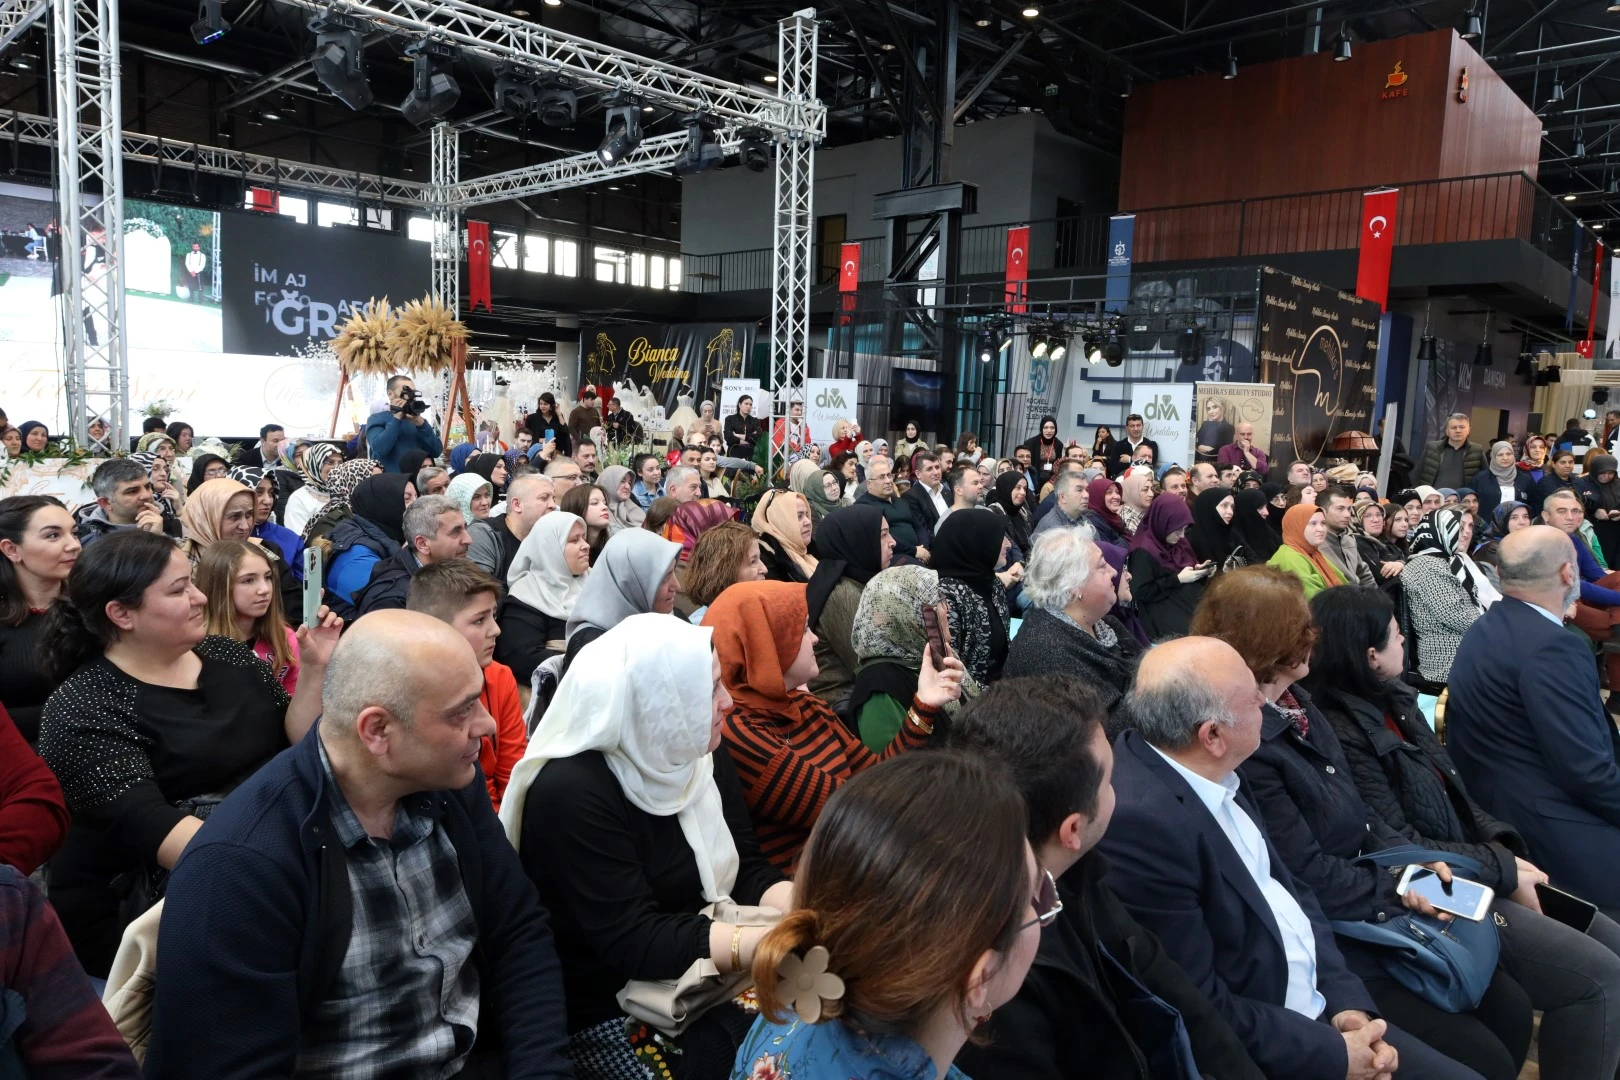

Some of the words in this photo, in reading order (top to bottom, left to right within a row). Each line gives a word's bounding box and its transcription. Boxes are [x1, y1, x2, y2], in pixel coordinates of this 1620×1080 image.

[1381, 88, 1409, 99] KAFE
[628, 337, 680, 366] Bianca
[649, 362, 690, 385] Wedding
[1228, 388, 1251, 396] BEAUTY
[1251, 389, 1272, 397] STUDIO
